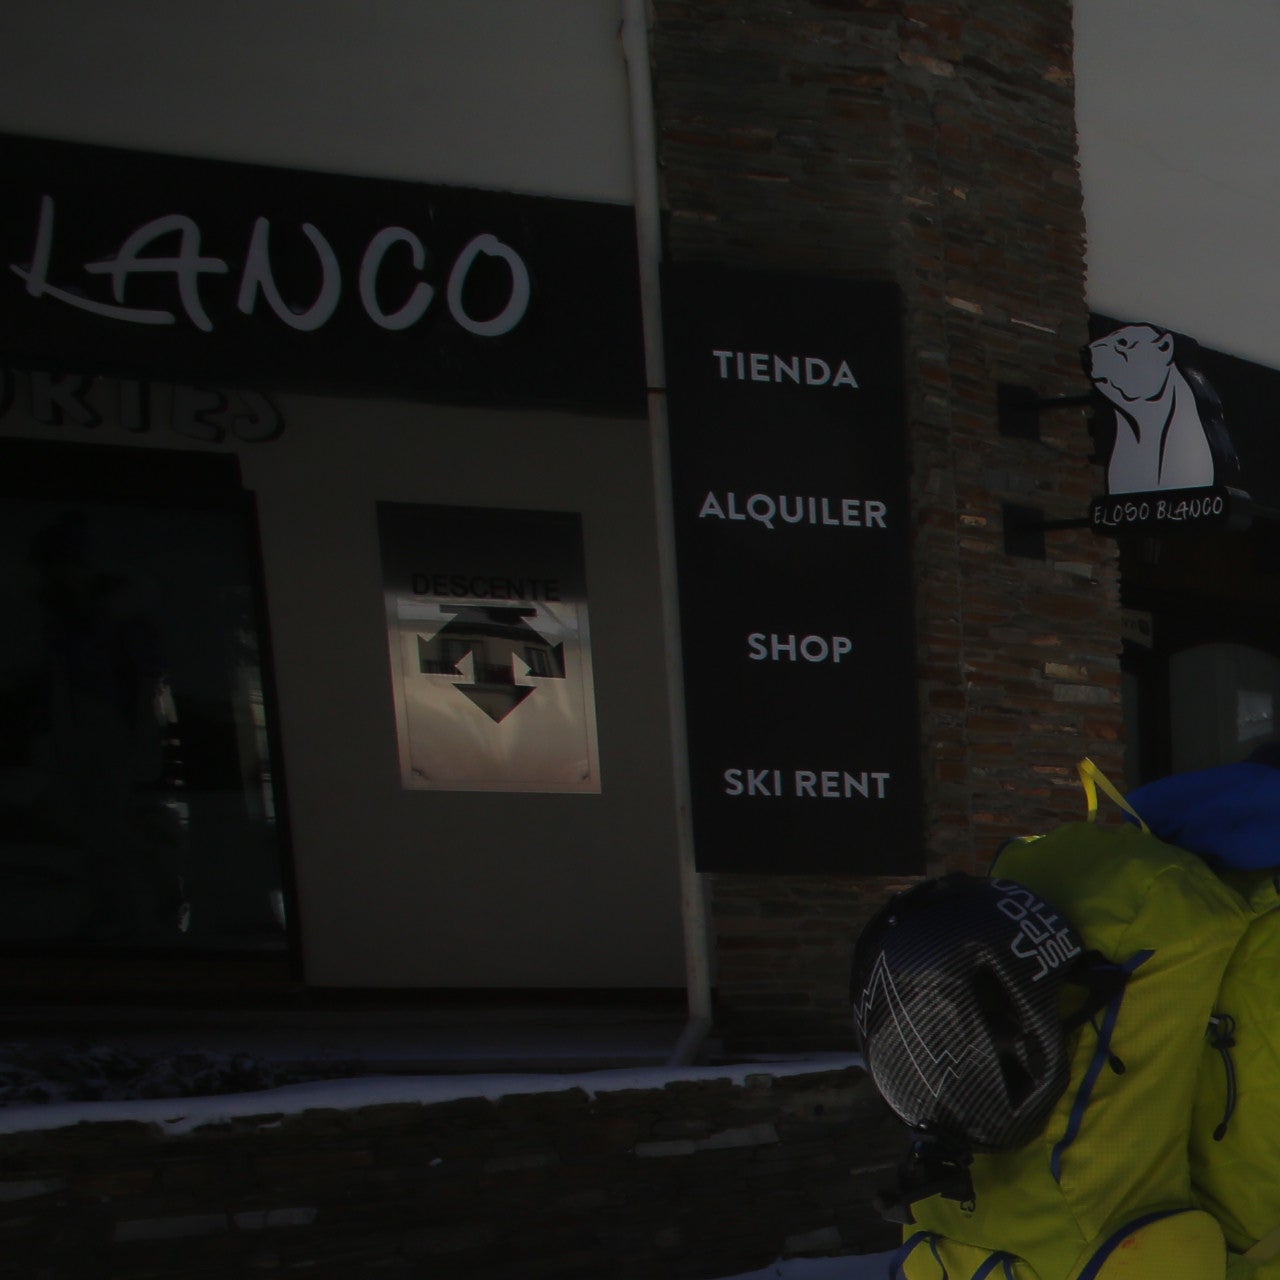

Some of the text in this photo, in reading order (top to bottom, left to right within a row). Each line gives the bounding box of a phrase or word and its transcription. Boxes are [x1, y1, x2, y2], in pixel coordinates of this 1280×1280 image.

[713, 349, 860, 390] TIENDA
[698, 490, 888, 529] ALQUILER
[1156, 496, 1223, 521] BLANCO
[411, 573, 561, 602] DESCENTE
[746, 632, 854, 664] SHOP
[722, 768, 891, 799] SKI RENT
